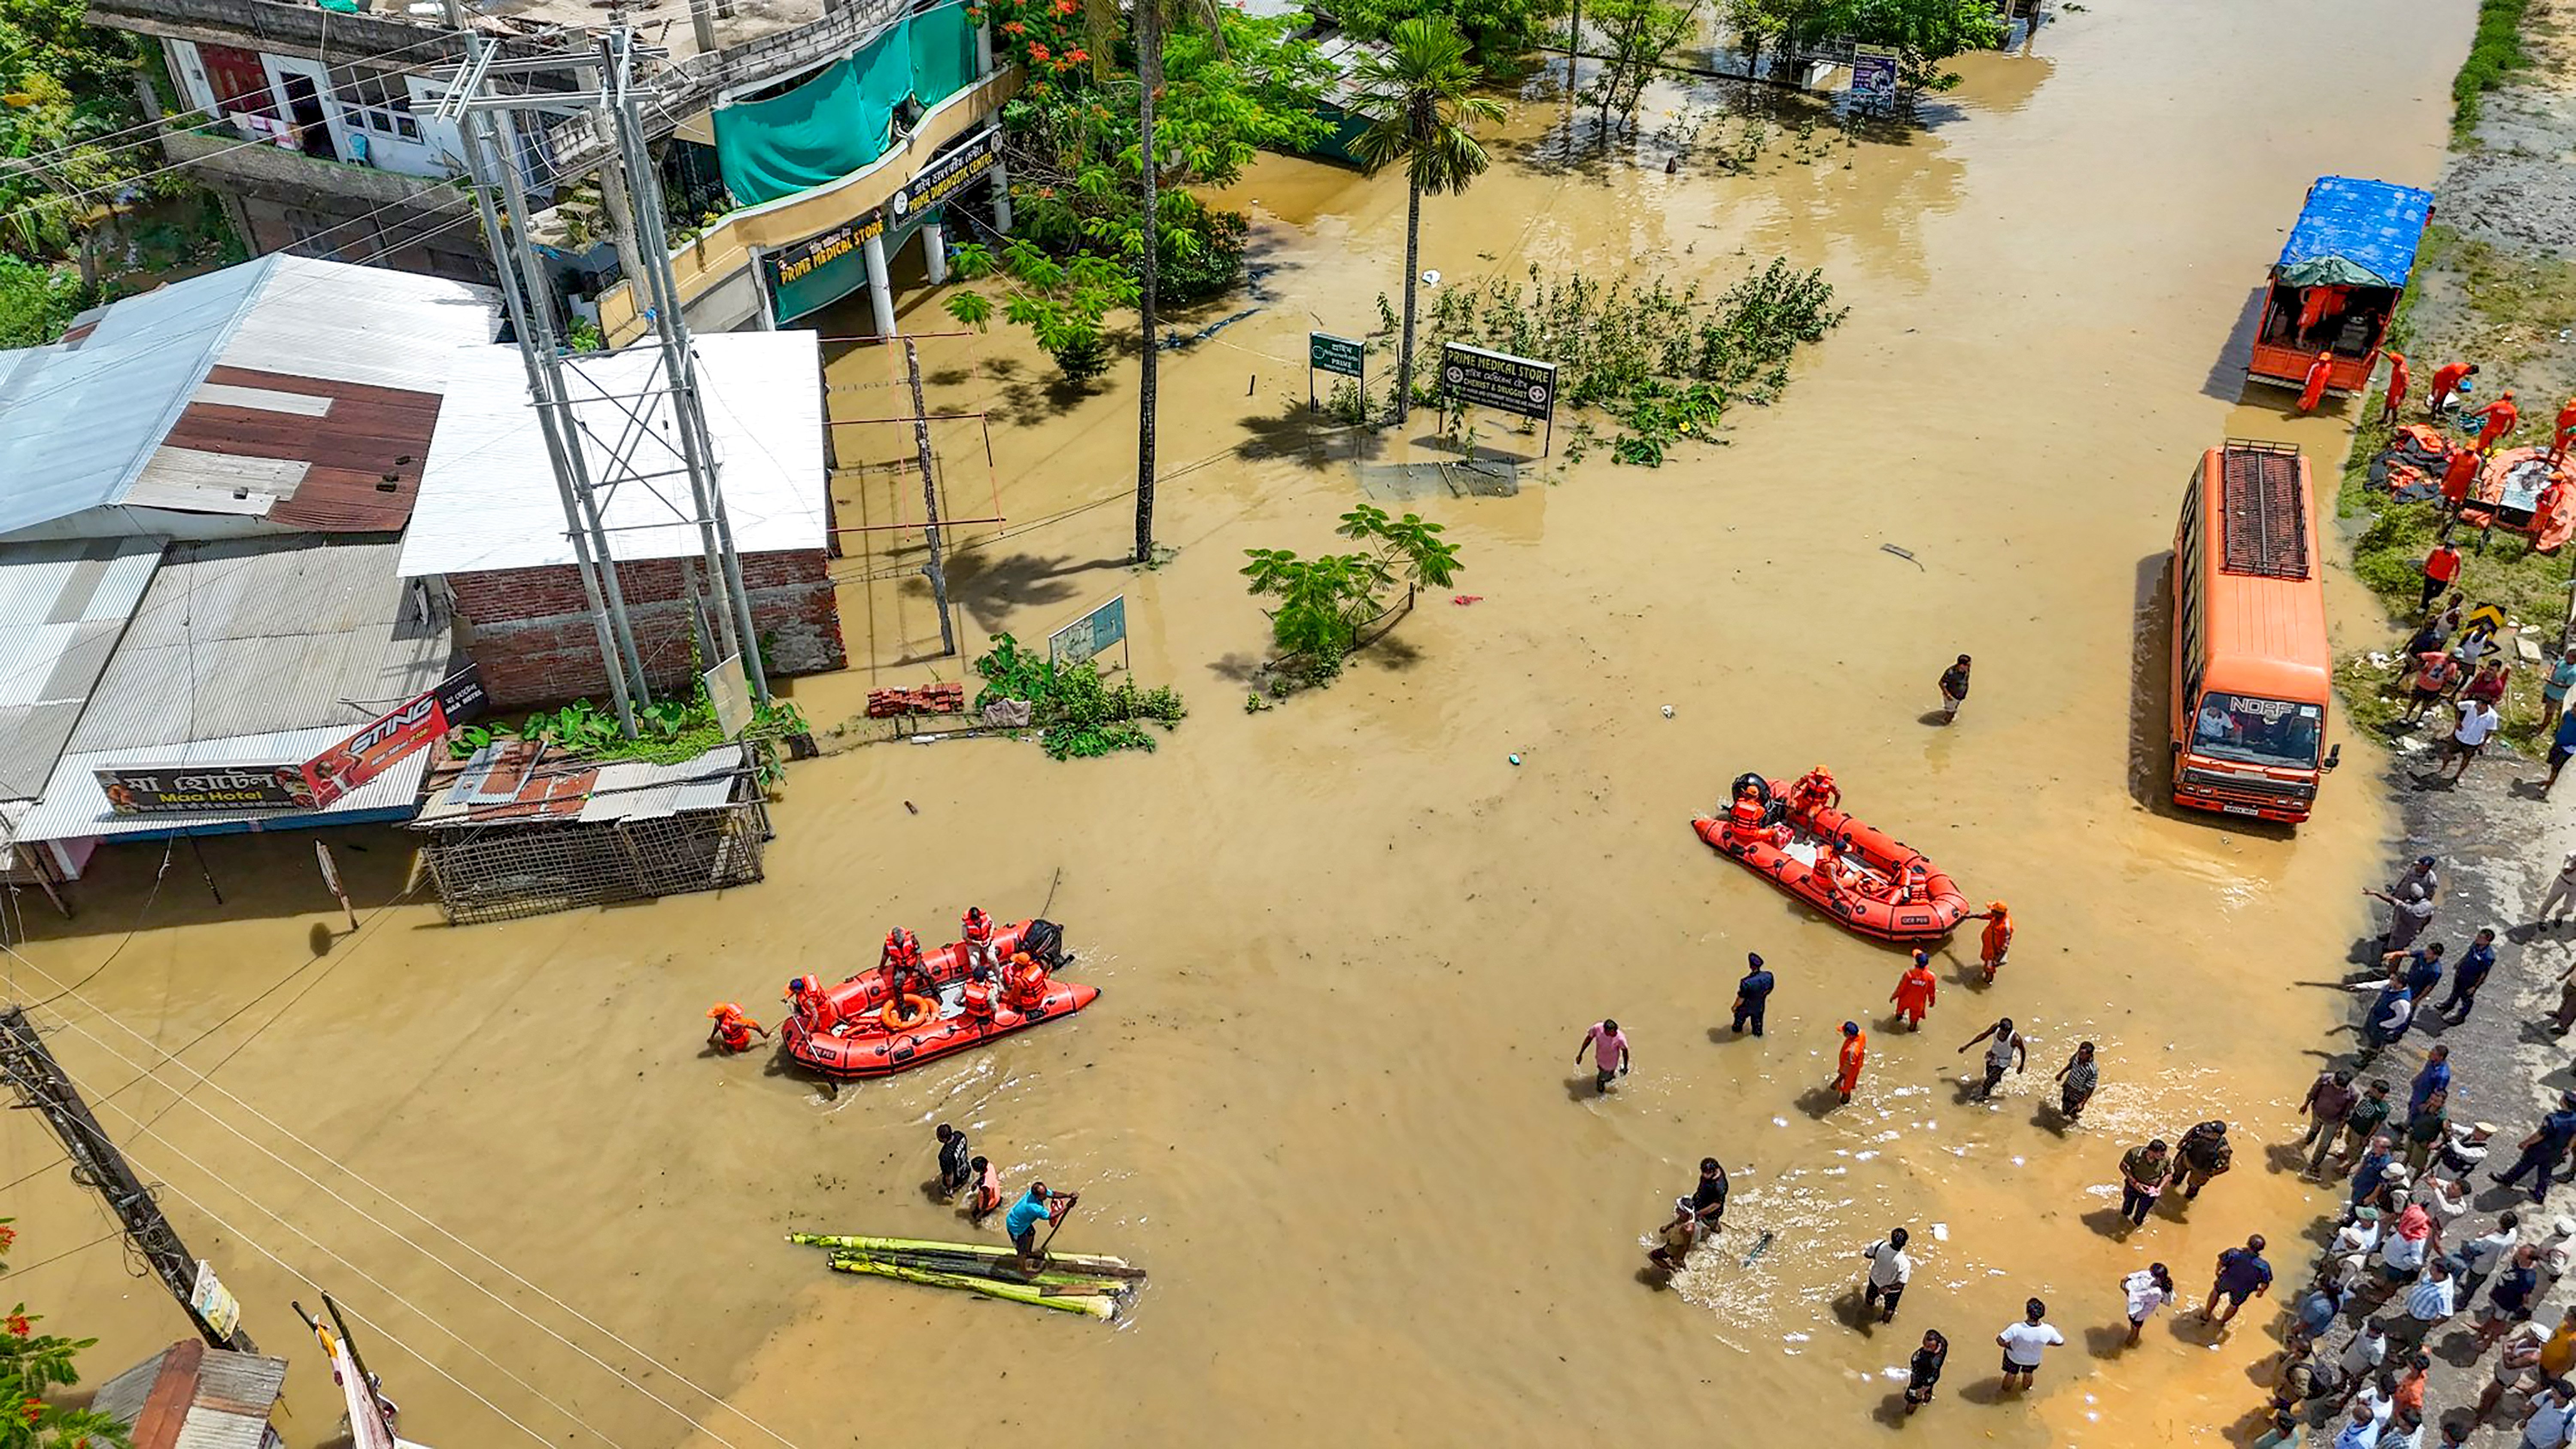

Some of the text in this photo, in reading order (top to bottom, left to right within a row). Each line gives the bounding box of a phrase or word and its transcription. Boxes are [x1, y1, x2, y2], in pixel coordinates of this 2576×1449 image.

[908, 191, 930, 213] PRIME
[969, 151, 993, 174] CENTRE
[780, 257, 811, 286] PRIME
[813, 237, 853, 267] MEDICAL
[854, 219, 884, 245] STORE
[1331, 358, 1352, 368] PRIME
[1448, 350, 1549, 383] PRIME MEDICAL STORE
[1464, 378, 1490, 390] CHEMIST
[445, 689, 483, 715] MAA HOTEL
[2230, 696, 2294, 717] NDRF
[349, 694, 436, 755] STING
[124, 768, 276, 792] মা হোটেল
[159, 791, 262, 803] Maa Hotel
